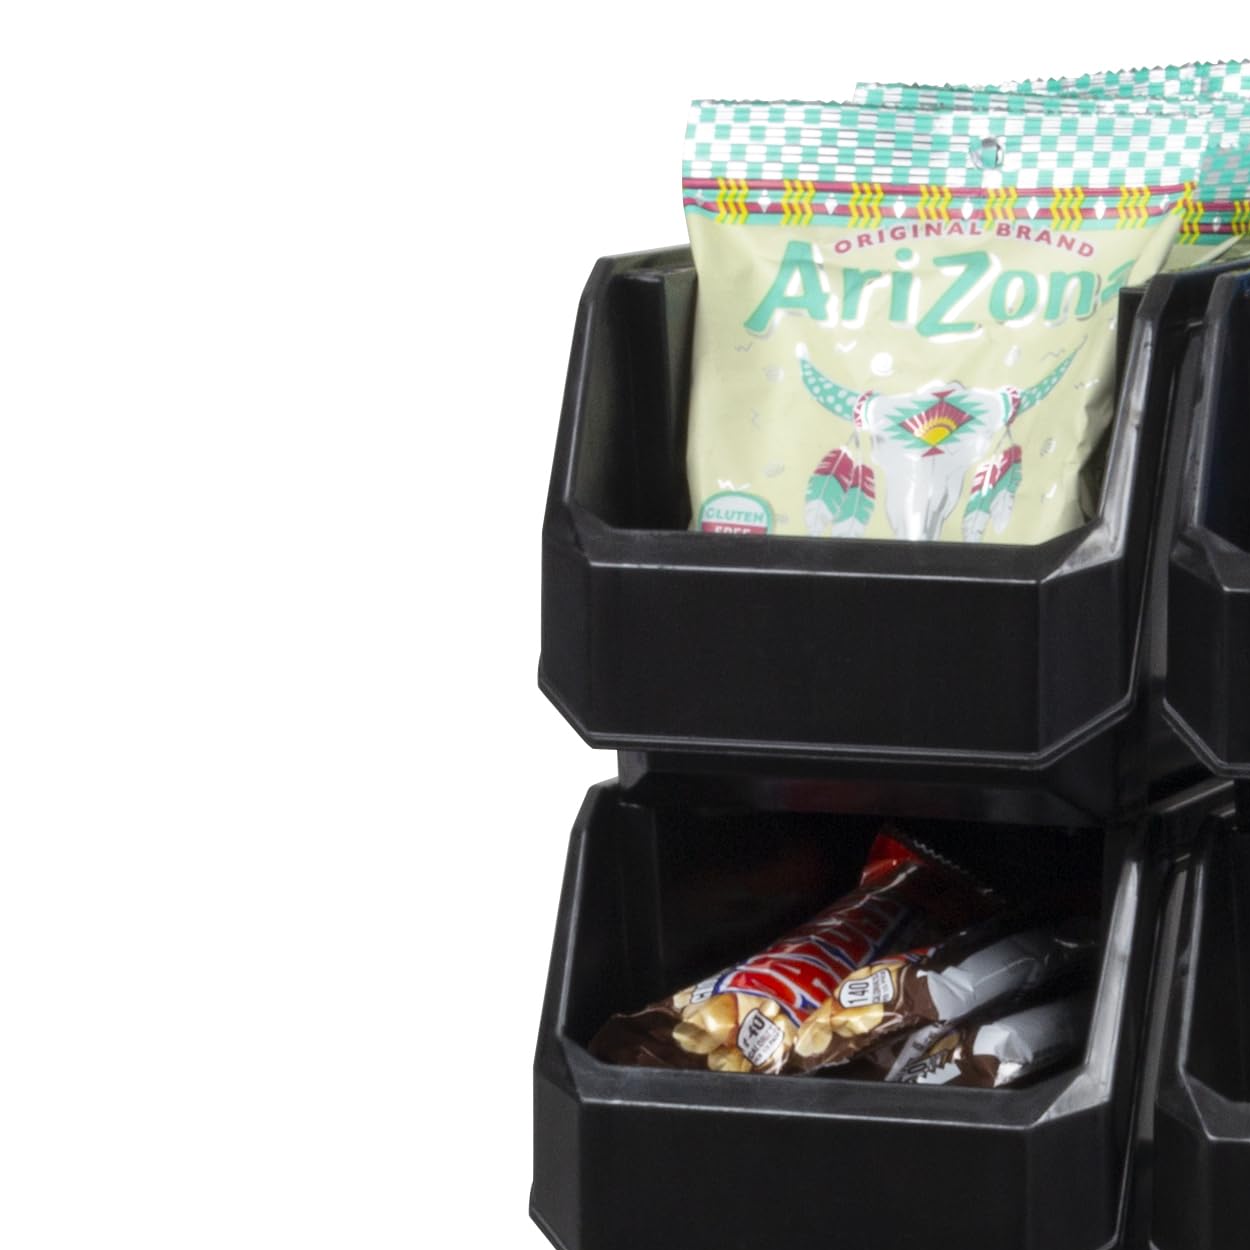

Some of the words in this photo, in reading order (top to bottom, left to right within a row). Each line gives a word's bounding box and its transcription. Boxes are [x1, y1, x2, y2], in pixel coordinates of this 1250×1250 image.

[834, 222, 982, 254] ORIGINAL
[996, 223, 1095, 258] BRAND
[705, 507, 765, 523] GLUTEN
[848, 981, 869, 1004] 140
